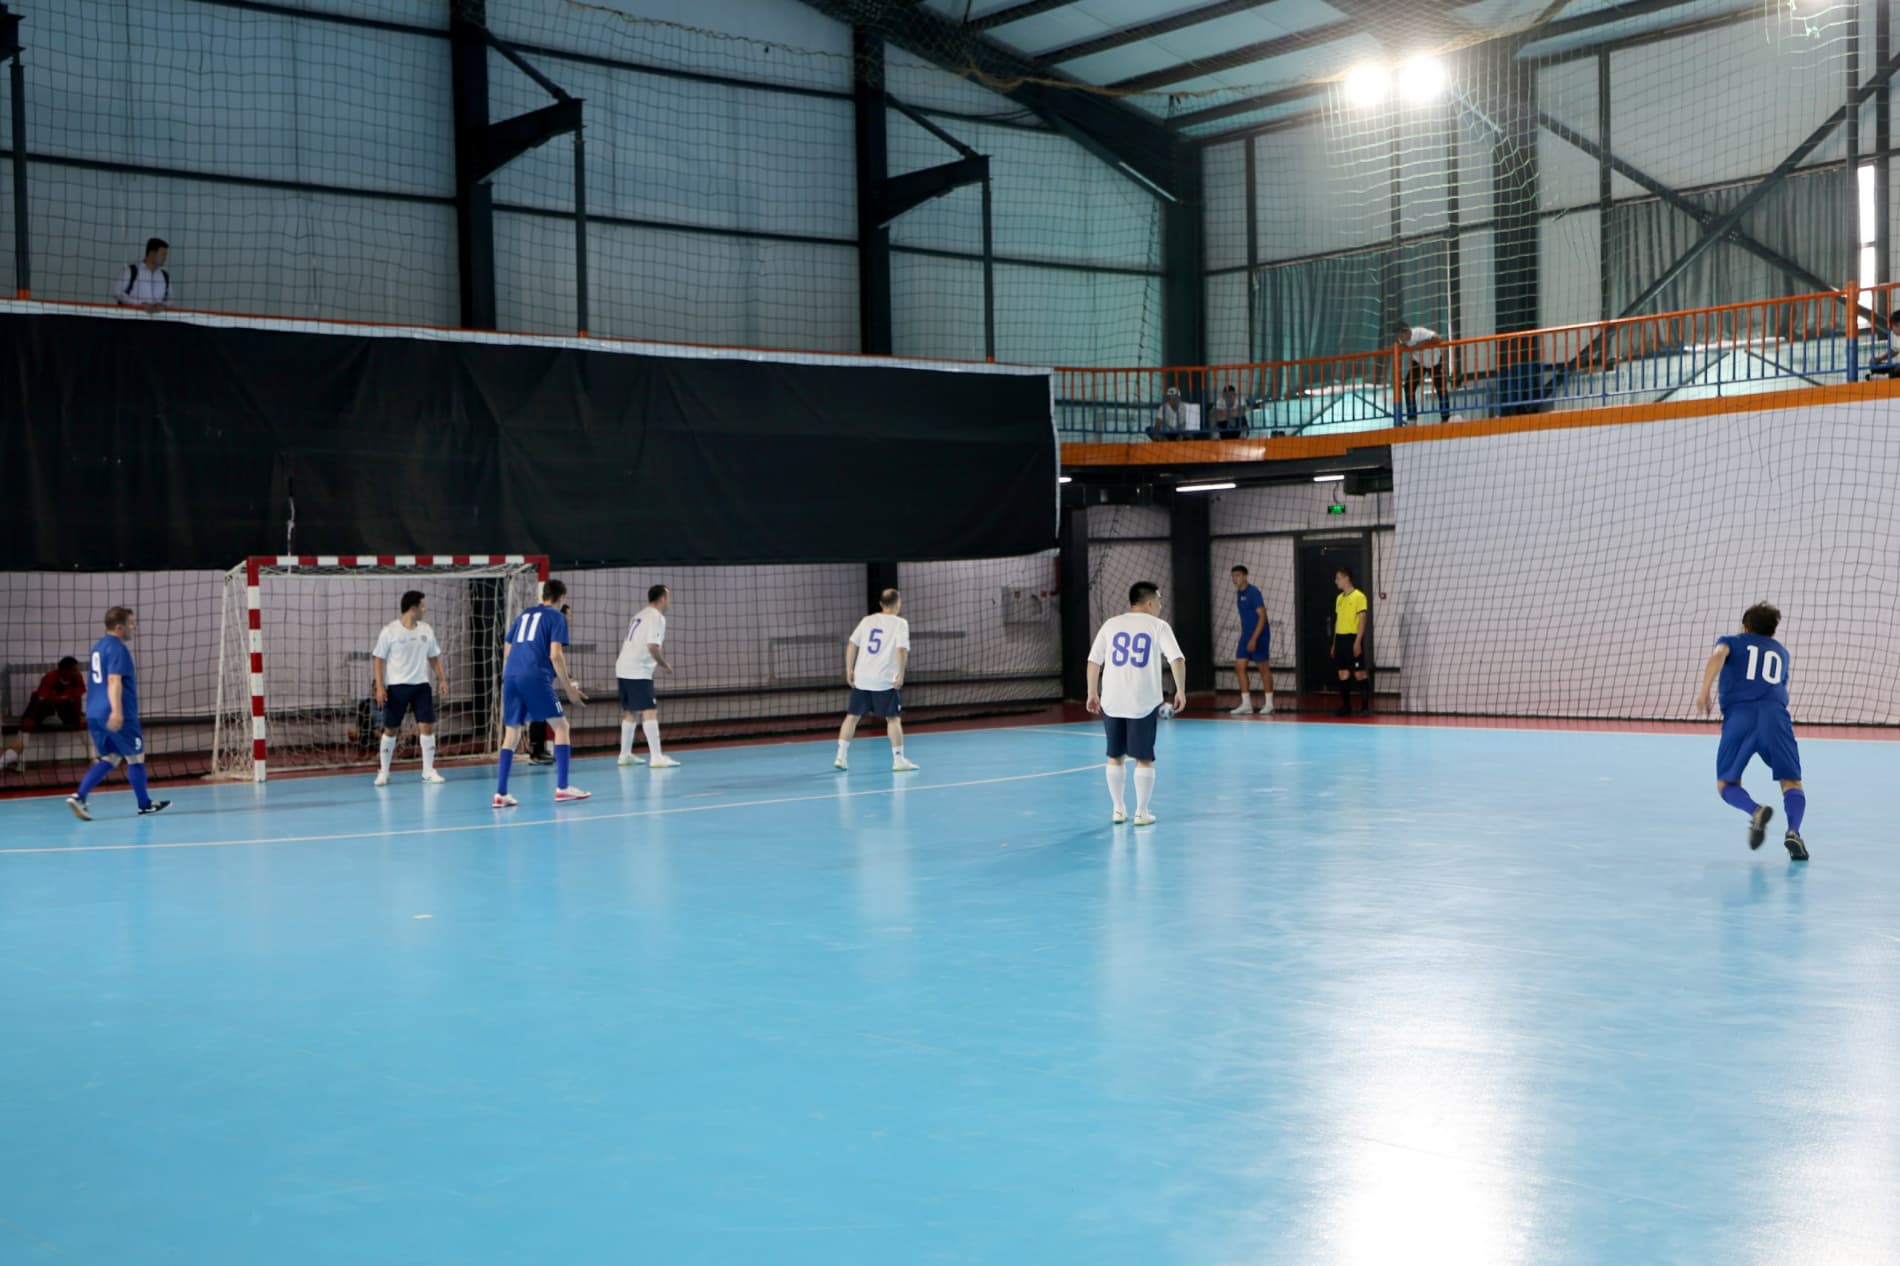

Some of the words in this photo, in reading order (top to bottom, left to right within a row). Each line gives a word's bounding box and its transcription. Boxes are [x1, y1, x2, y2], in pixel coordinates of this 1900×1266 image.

[517, 612, 542, 642] 11
[867, 628, 884, 654] 5
[1112, 631, 1152, 668] 89
[1746, 645, 1782, 684] 10
[92, 651, 103, 684] 9
